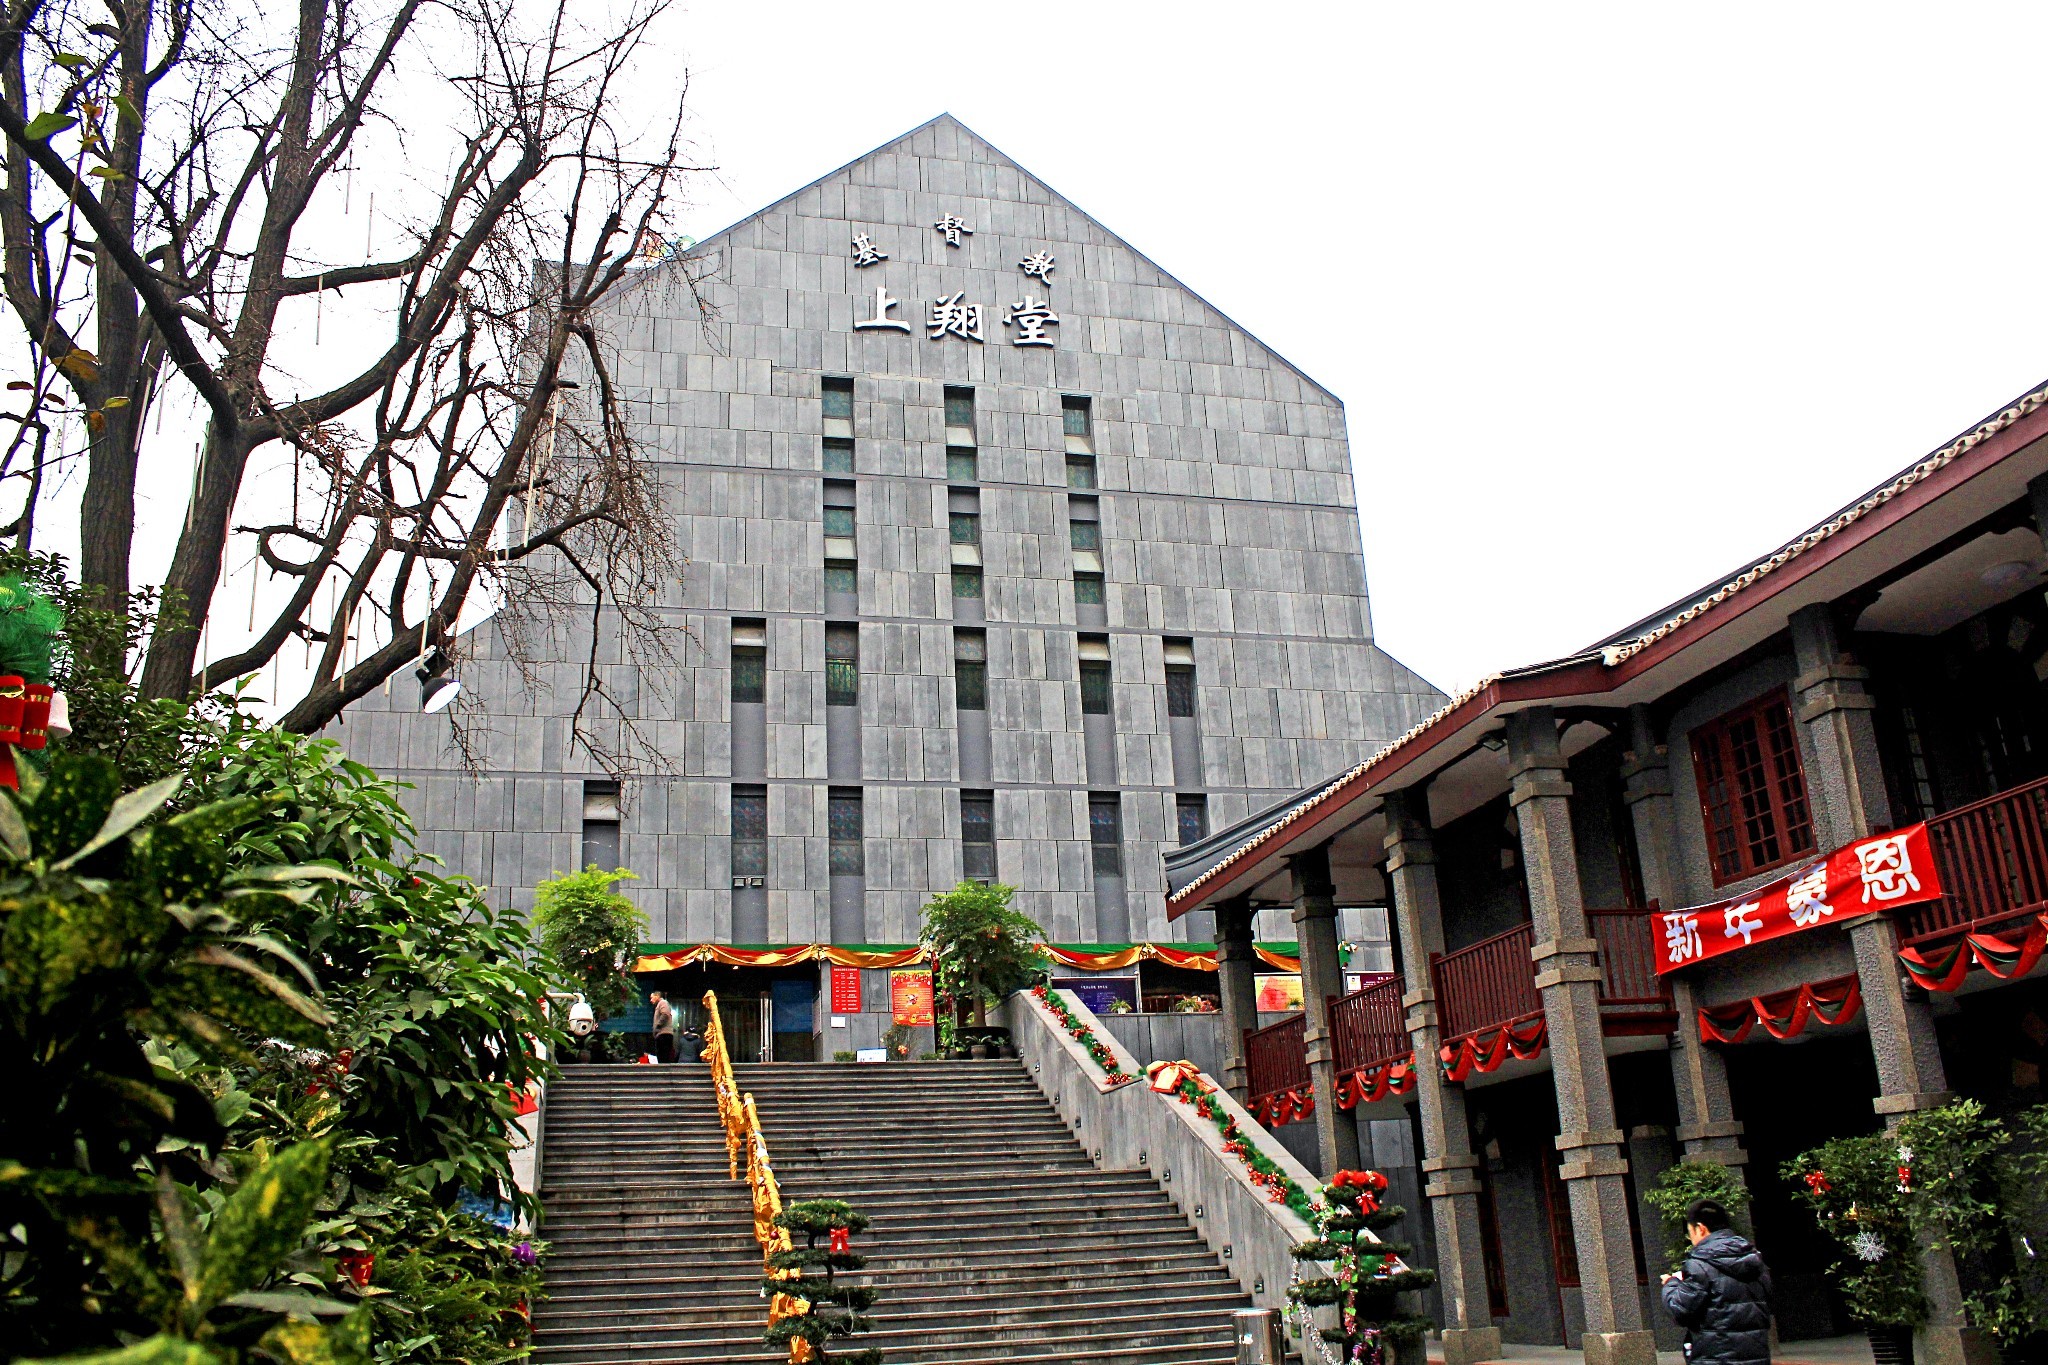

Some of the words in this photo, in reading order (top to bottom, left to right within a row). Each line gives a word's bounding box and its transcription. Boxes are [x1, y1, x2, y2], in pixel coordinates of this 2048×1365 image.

[853, 212, 1055, 287] 基督教
[853, 287, 1059, 347] 上翔堂
[1663, 834, 1921, 963] 新年蒙恩
